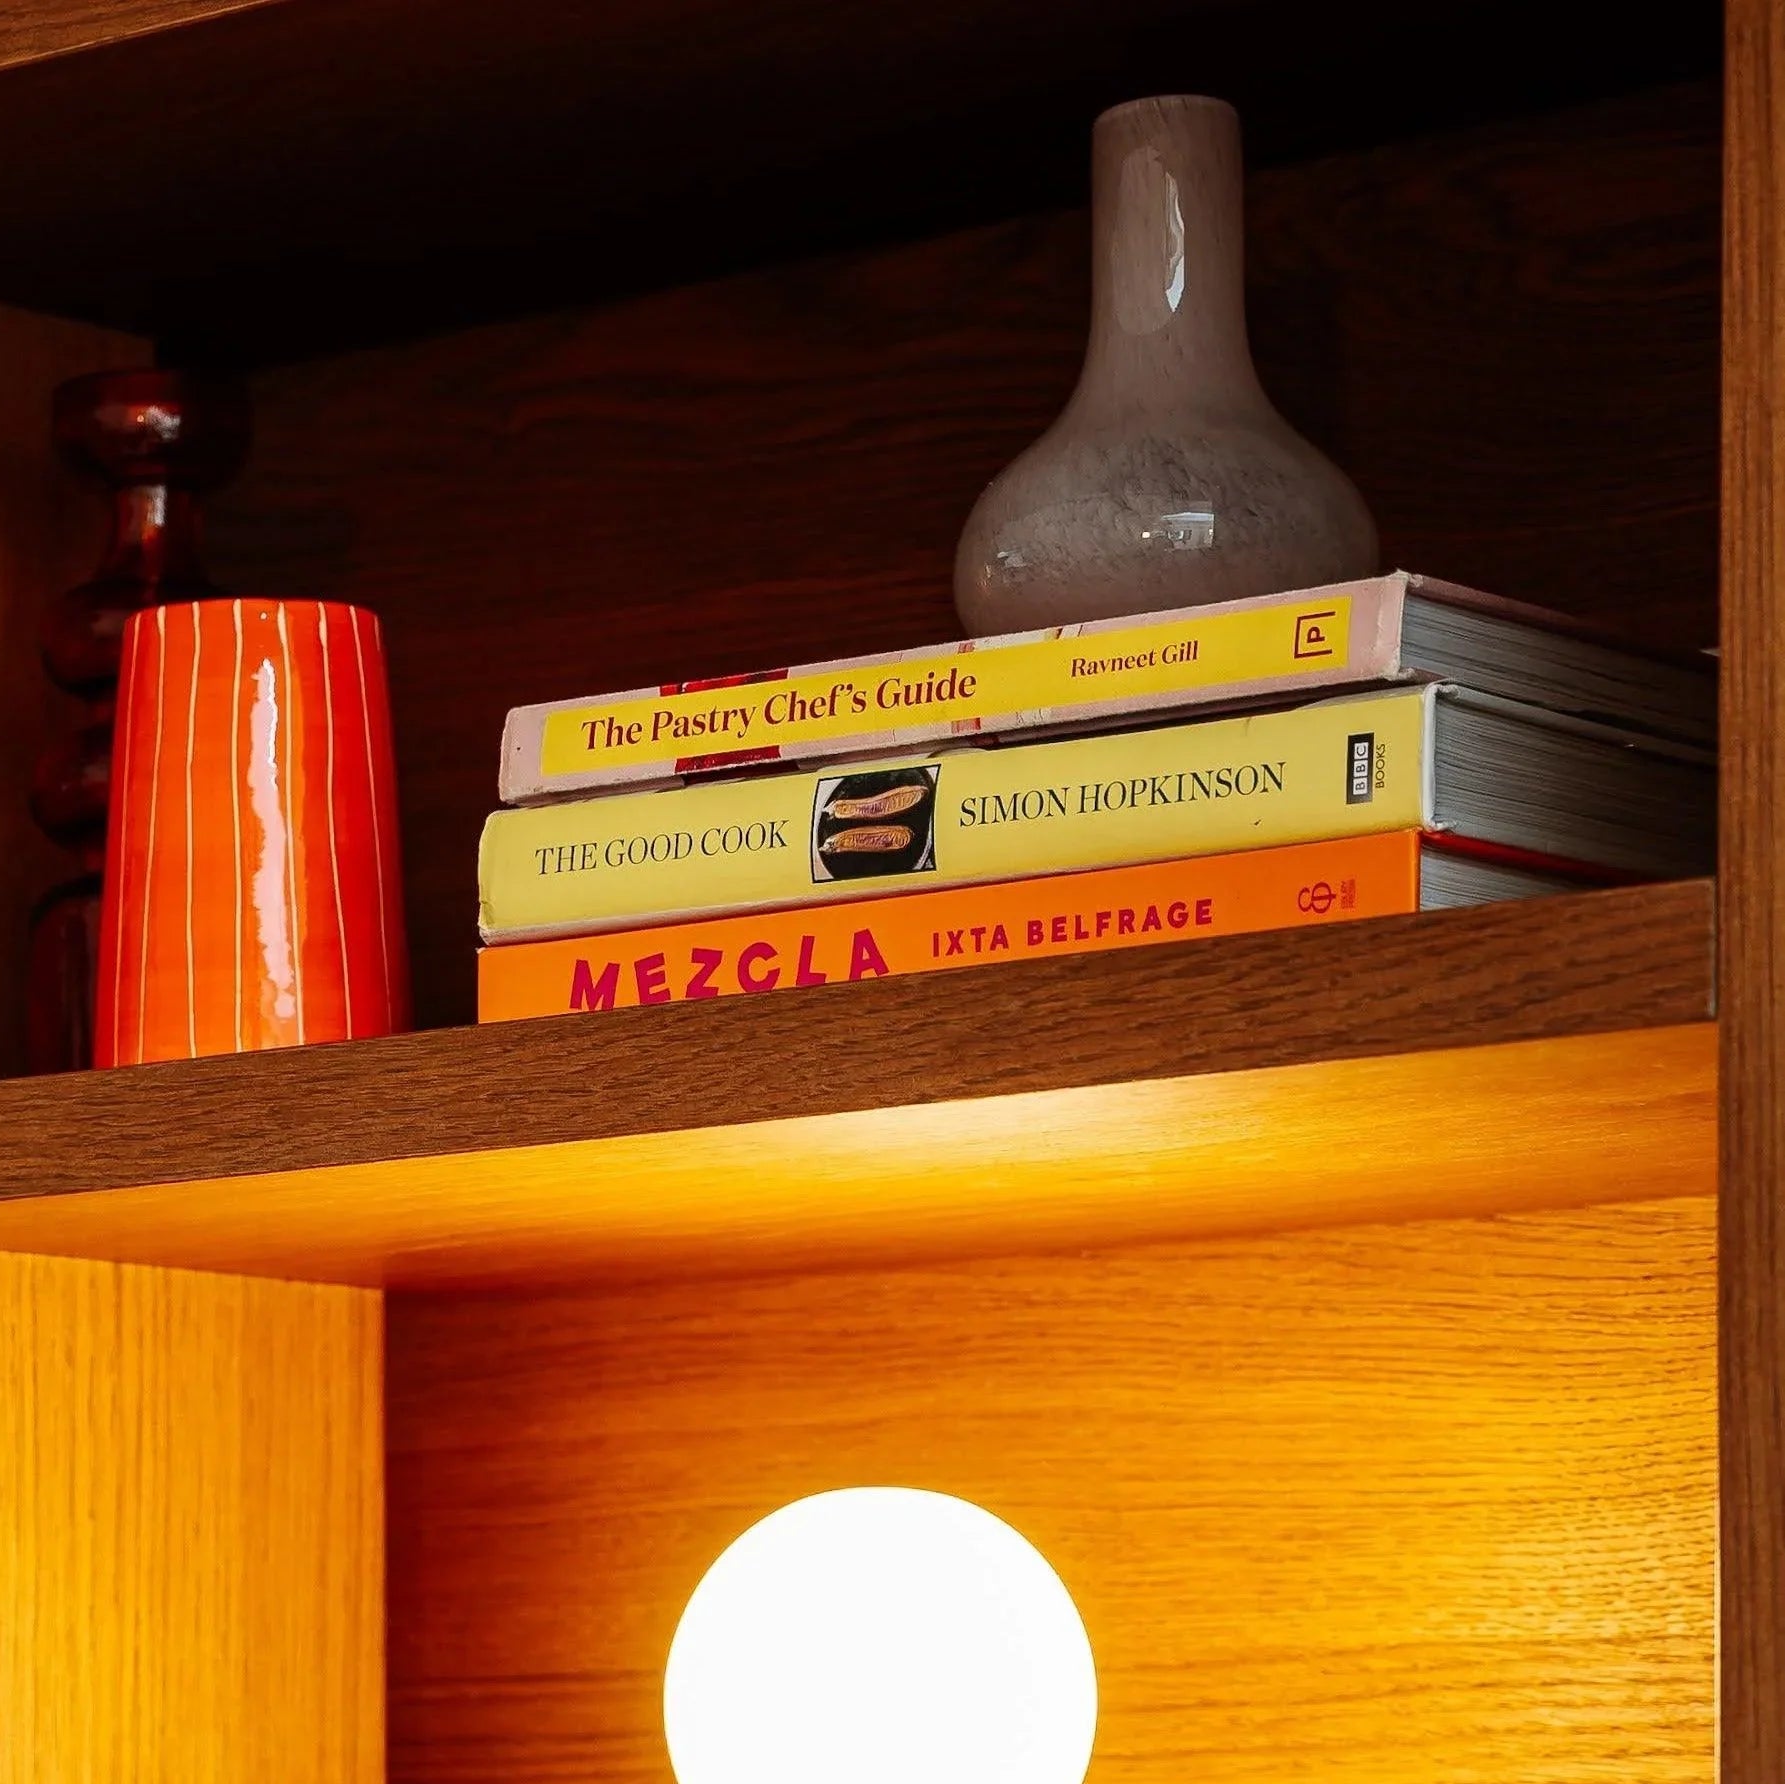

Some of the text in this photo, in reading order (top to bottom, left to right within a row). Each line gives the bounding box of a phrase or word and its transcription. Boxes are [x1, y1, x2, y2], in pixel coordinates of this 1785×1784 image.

[1071, 640, 1199, 678] Ravneet Gill
[582, 714, 643, 751] The
[651, 706, 757, 740] Pastry
[877, 668, 977, 710] Guide
[959, 761, 1287, 828] SIMON HOPKINSON
[1353, 742, 1369, 796] BBC
[1375, 743, 1386, 789] BOOKS
[535, 819, 789, 876] THE GOOD COOK
[932, 898, 1213, 958] IXTA BELFRAGE
[570, 928, 890, 1011] MEZCLA
